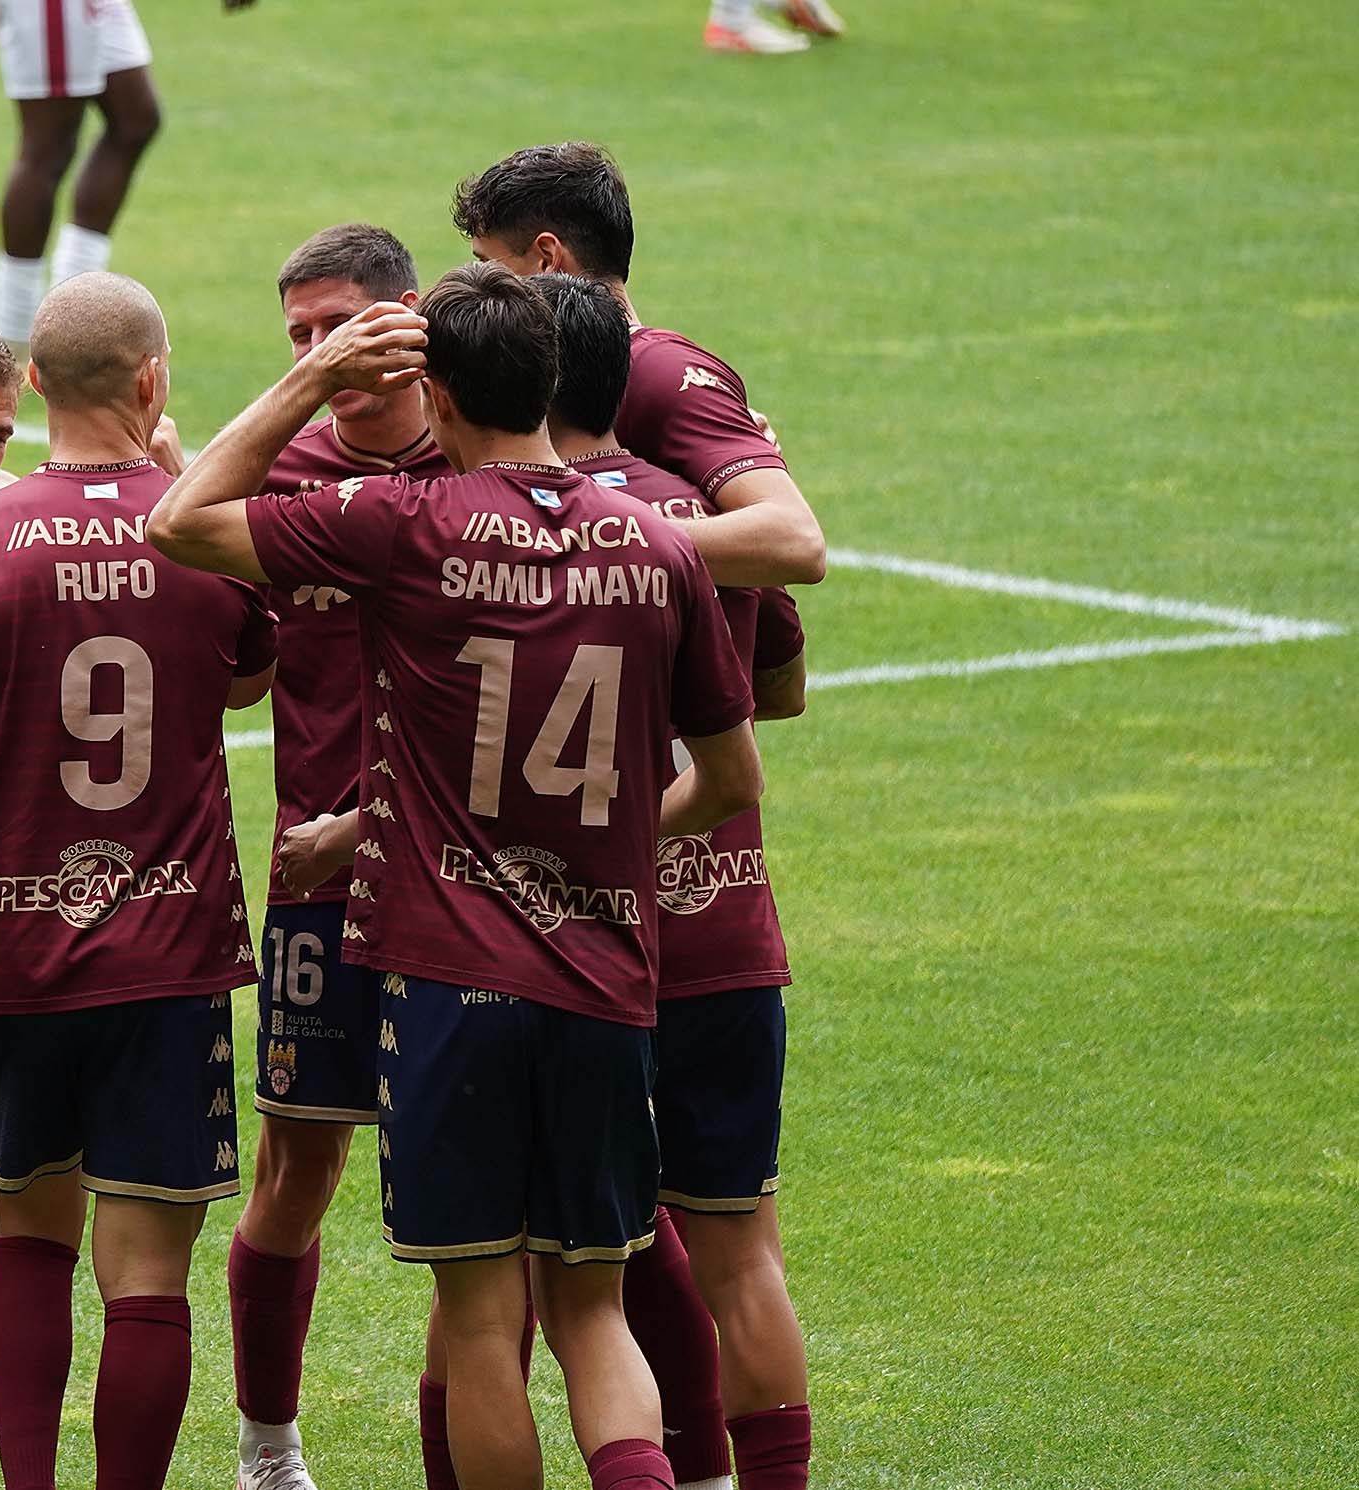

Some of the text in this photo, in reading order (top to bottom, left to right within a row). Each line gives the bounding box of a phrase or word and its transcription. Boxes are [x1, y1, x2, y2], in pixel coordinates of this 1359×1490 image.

[119, 458, 149, 468] VOLTAR
[497, 462, 518, 470] NON
[519, 463, 549, 474] PARAR
[718, 459, 754, 478] VOLTAR
[54, 558, 157, 602] RUFO
[441, 556, 669, 608] SAMU MAYO
[59, 635, 154, 812] 9
[454, 635, 625, 827] 14
[58, 838, 136, 863] CONSERVAS
[492, 845, 568, 873] CONSERVAS
[268, 926, 325, 1007] 16
[284, 1024, 347, 1041] DE GALICIA
[286, 1013, 324, 1027] XUNTA
